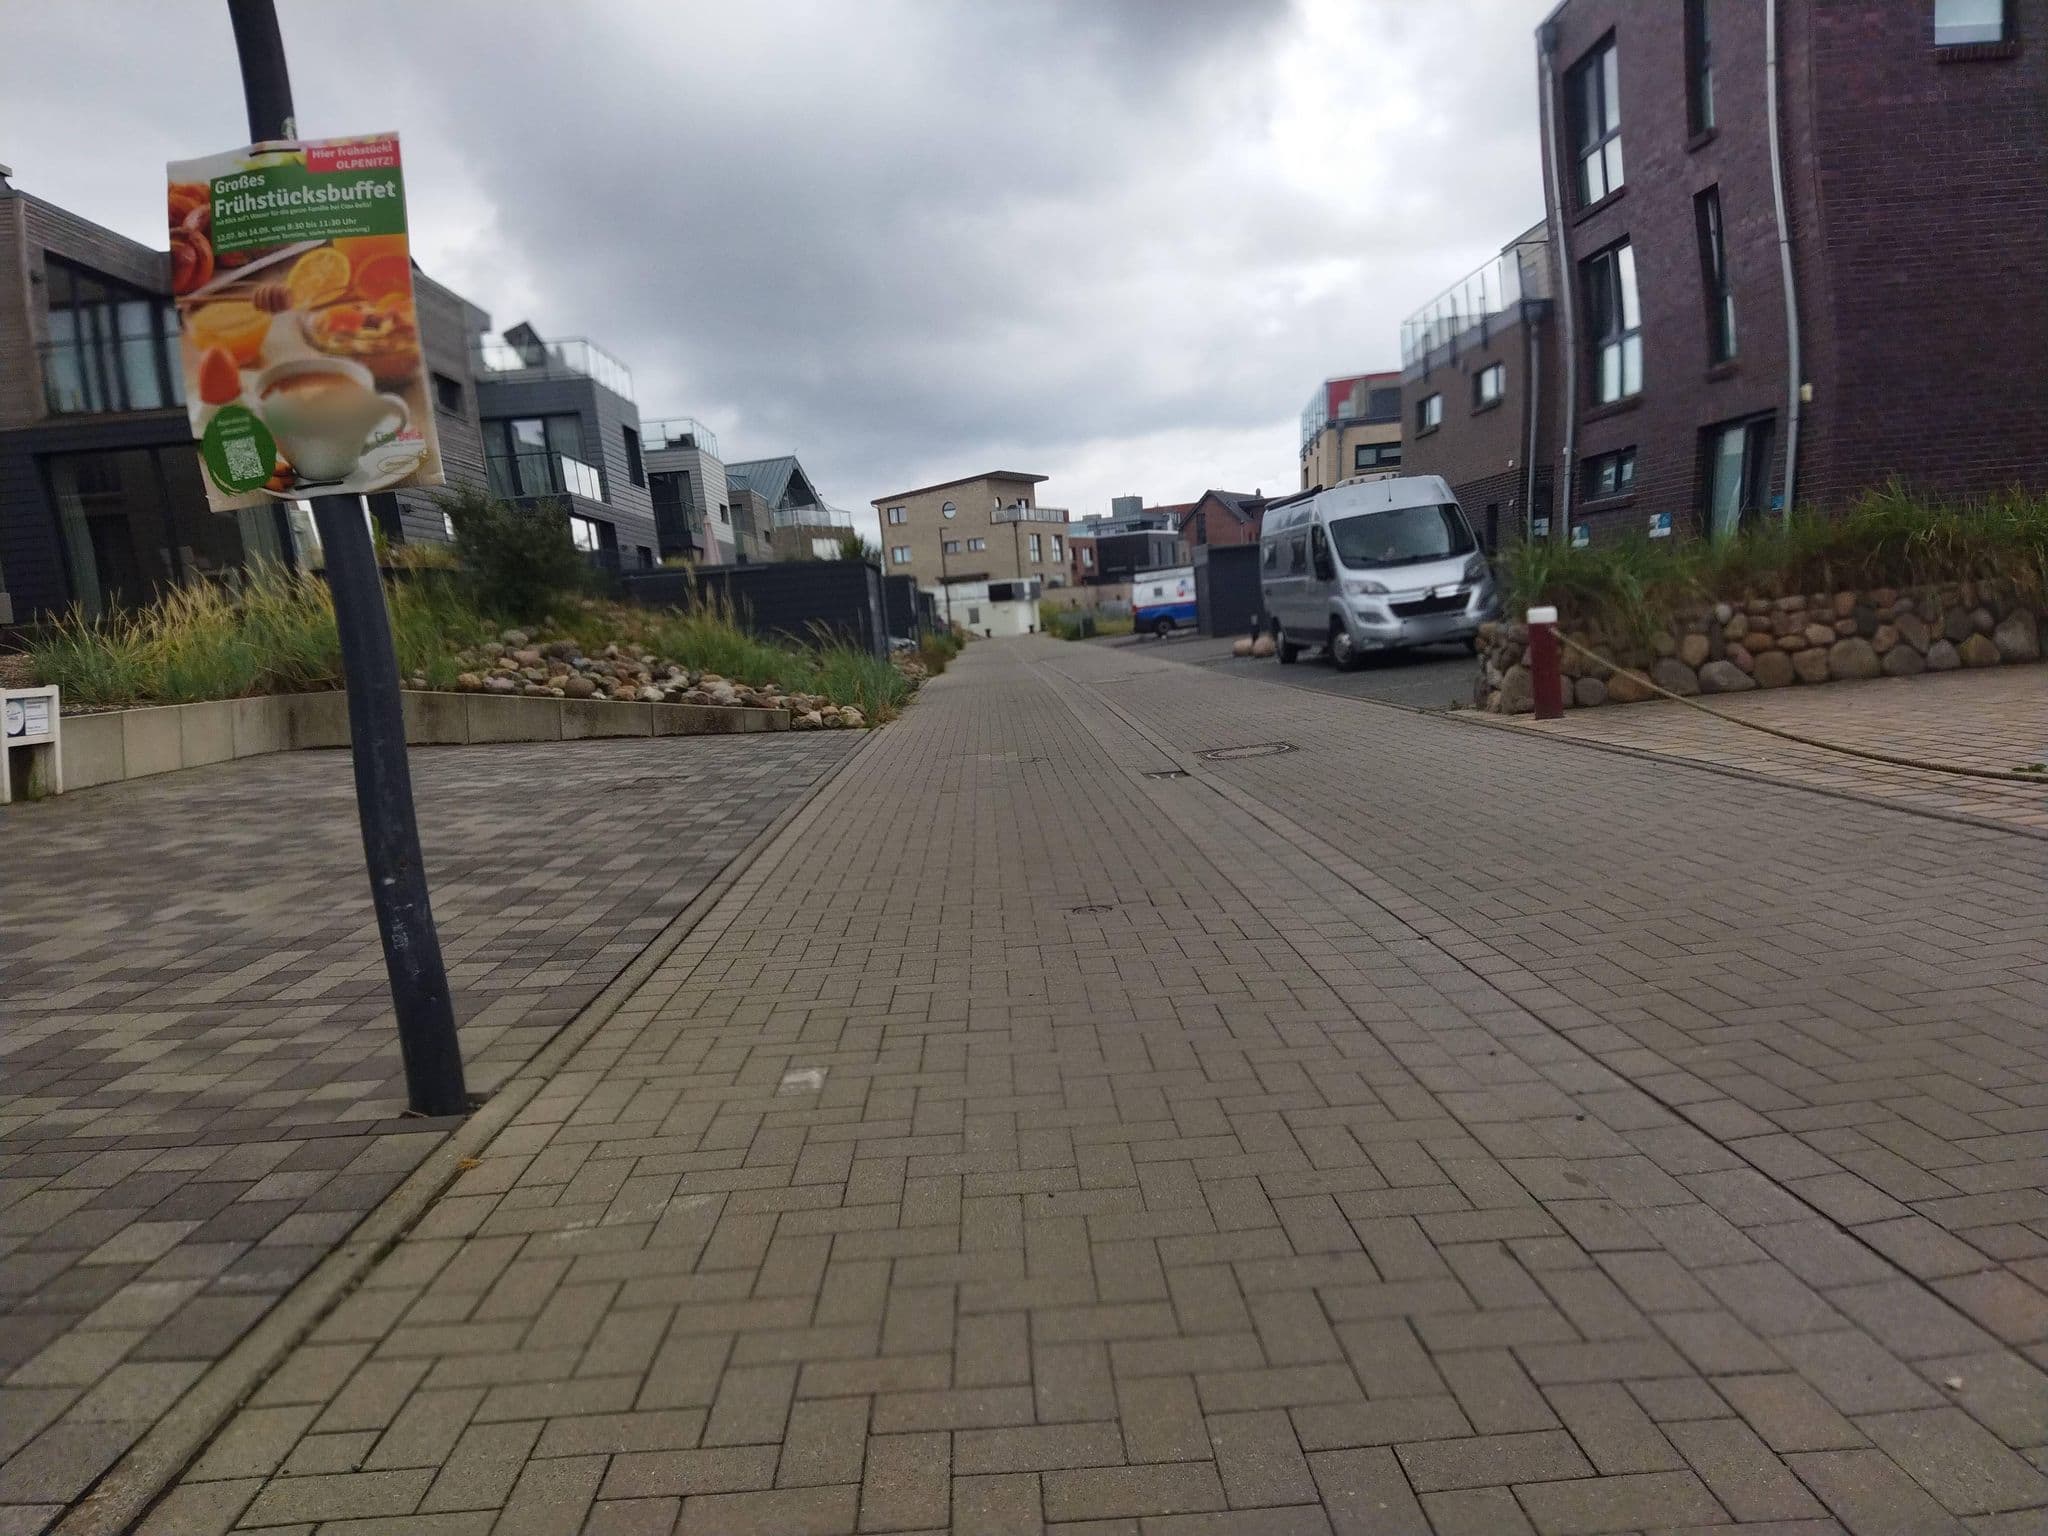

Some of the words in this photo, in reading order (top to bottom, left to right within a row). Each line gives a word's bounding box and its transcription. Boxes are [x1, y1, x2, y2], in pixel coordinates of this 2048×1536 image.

[312, 149, 335, 159] Hier
[336, 156, 394, 170] OLPENITZ!
[214, 175, 266, 194] Großes
[214, 180, 397, 218] Frühstücksbuffet
[342, 217, 357, 226] Uhr
